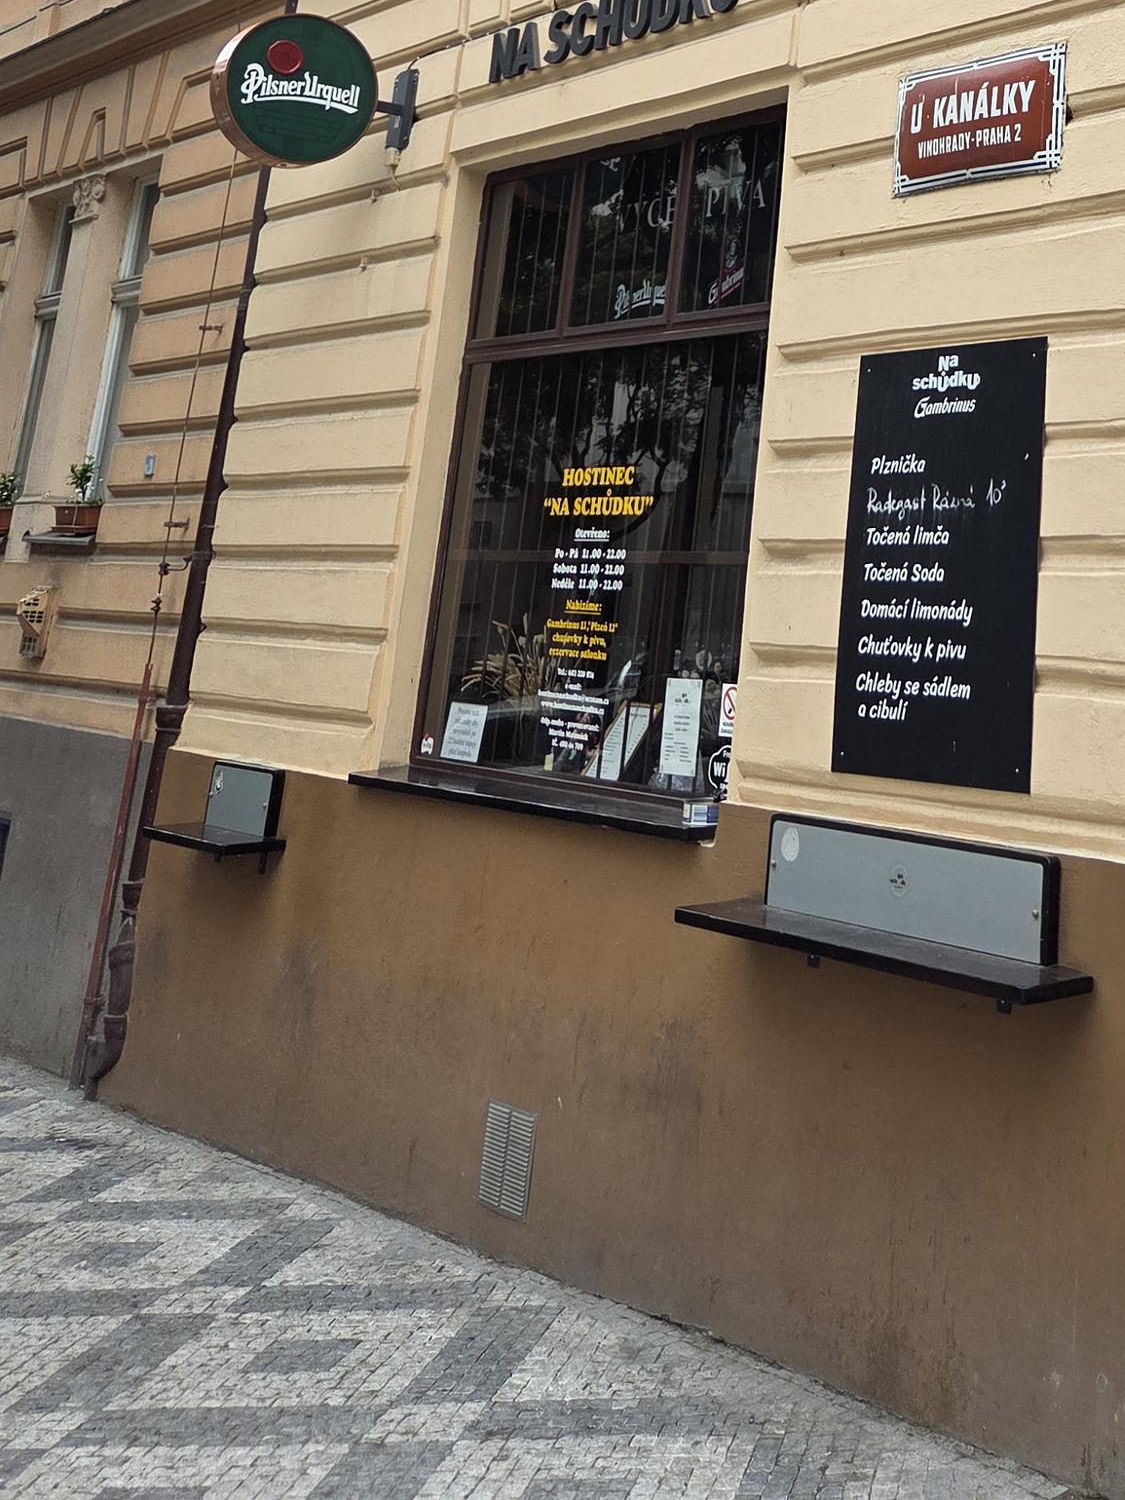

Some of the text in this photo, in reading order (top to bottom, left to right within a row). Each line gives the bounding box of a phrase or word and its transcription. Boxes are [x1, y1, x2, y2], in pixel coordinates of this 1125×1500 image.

[489, 21, 540, 83] NA
[240, 62, 361, 111] Pilsner Urquell
[910, 80, 1036, 134] U KANÁLKY
[1014, 123, 1022, 142] 2
[938, 355, 959, 372] Na
[914, 396, 977, 418] Gambrinus
[871, 453, 926, 474] Plznička
[562, 466, 635, 487] HOSTINEC
[866, 485, 926, 520] Radegast
[866, 525, 950, 546] Točená limča
[554, 548, 564, 559] Po
[553, 563, 577, 574] Sobota
[864, 562, 945, 582] Točená Soda
[551, 579, 575, 589] Neděle
[860, 598, 973, 627] Domácí limonády
[858, 634, 967, 663] Chuťovky k pivu
[856, 671, 972, 700] Chleby se sádlem
[858, 699, 909, 721] a cibulí
